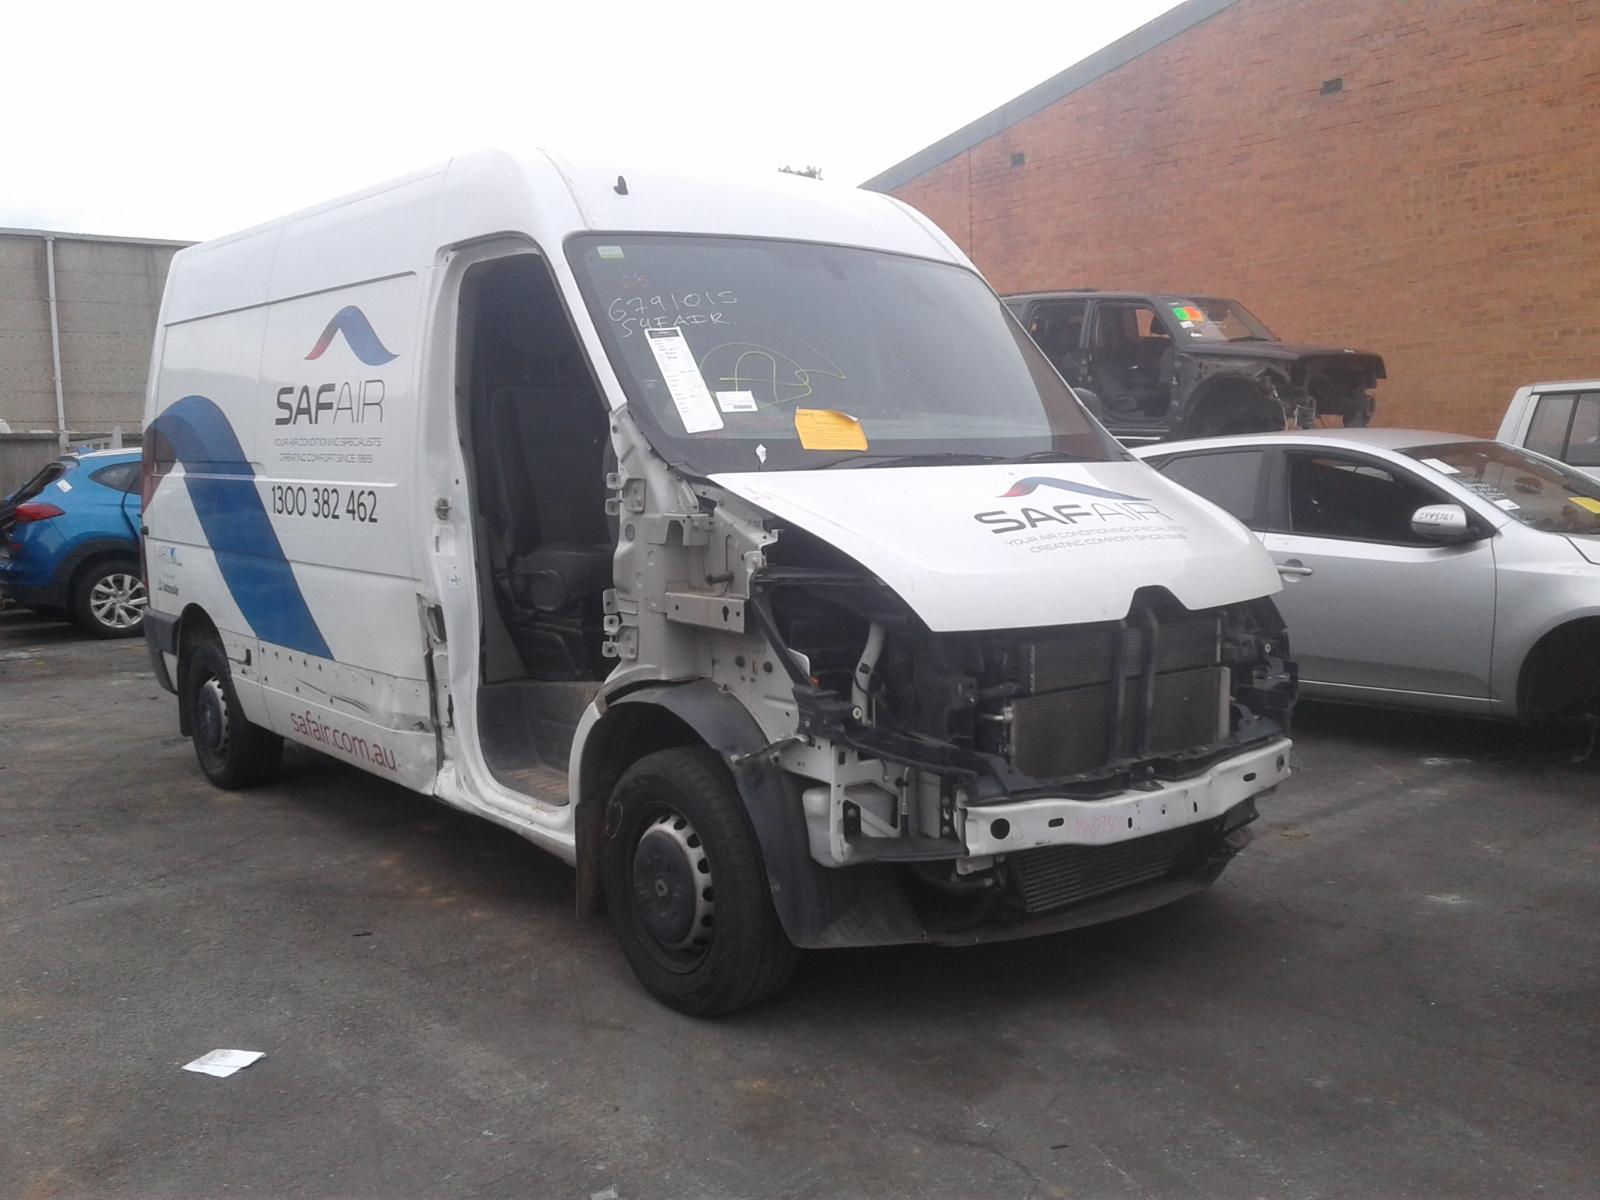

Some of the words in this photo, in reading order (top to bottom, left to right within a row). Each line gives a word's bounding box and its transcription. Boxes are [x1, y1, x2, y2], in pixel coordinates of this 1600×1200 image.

[275, 379, 385, 425] SAFAIR
[272, 485, 307, 516] 1300
[312, 487, 340, 519] 382
[346, 489, 378, 523] 462
[974, 502, 1173, 534] SAFAIR
[1006, 535, 1038, 546] YOUR
[1040, 533, 1057, 541] AIR
[1058, 526, 1129, 539] CONDITIONING
[1030, 540, 1085, 553] CREATING
[1085, 534, 1136, 545] COMFORT
[290, 710, 397, 772] safair.com.au
